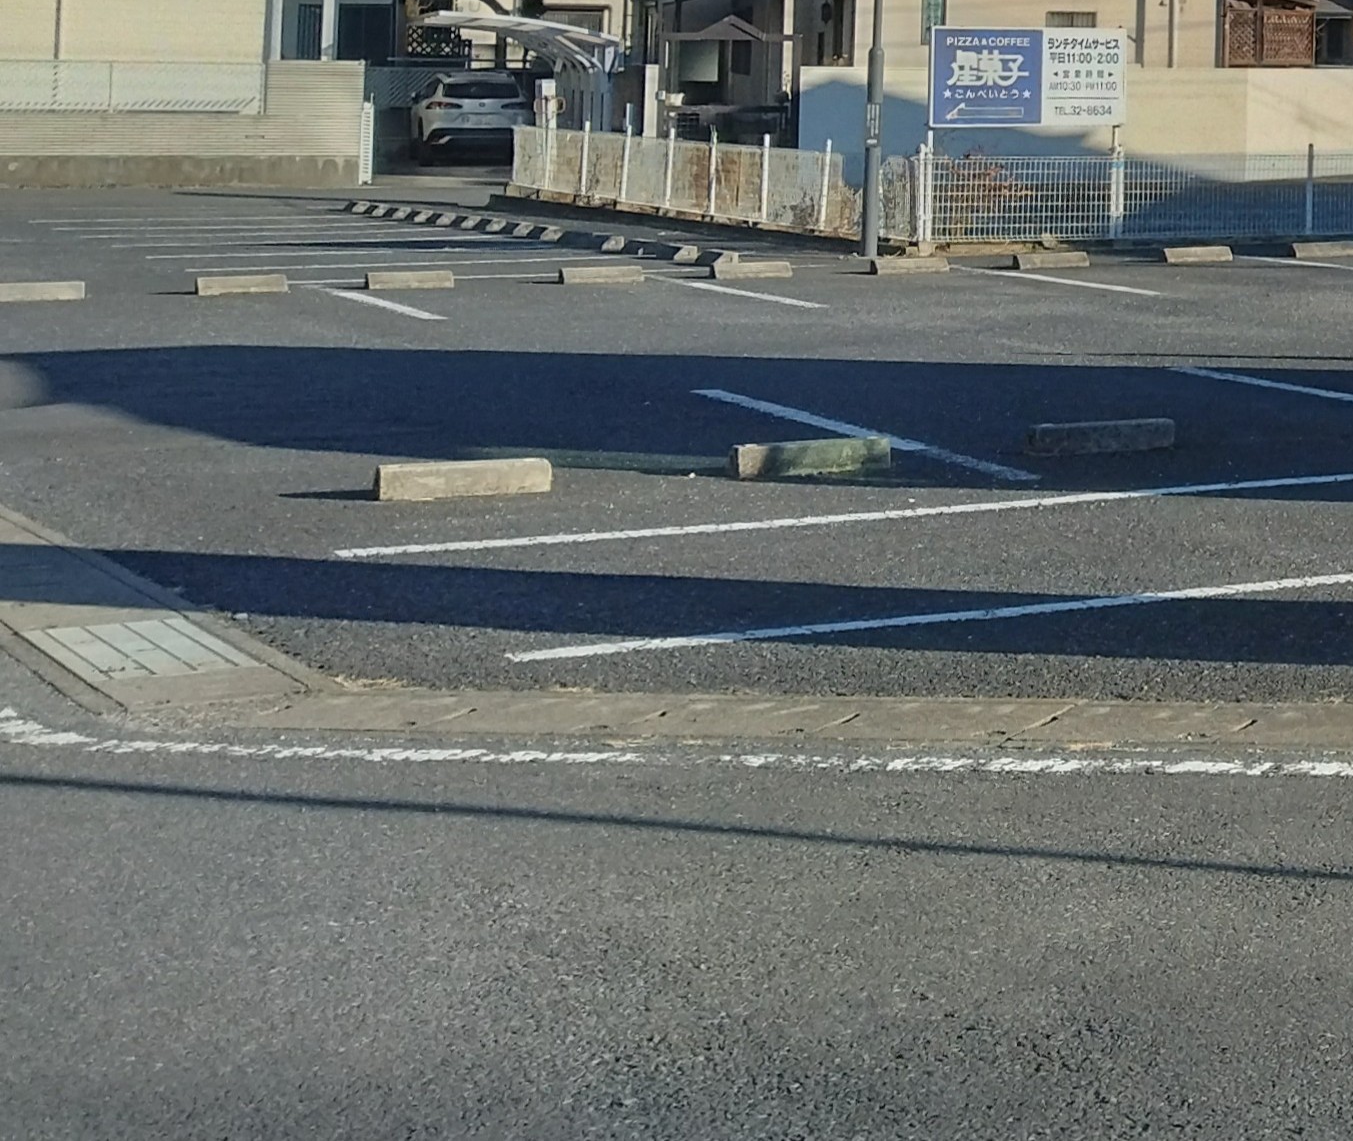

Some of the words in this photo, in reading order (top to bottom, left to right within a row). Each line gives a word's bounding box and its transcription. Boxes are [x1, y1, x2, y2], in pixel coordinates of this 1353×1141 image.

[1047, 37, 1121, 50] ランチタイムサービス
